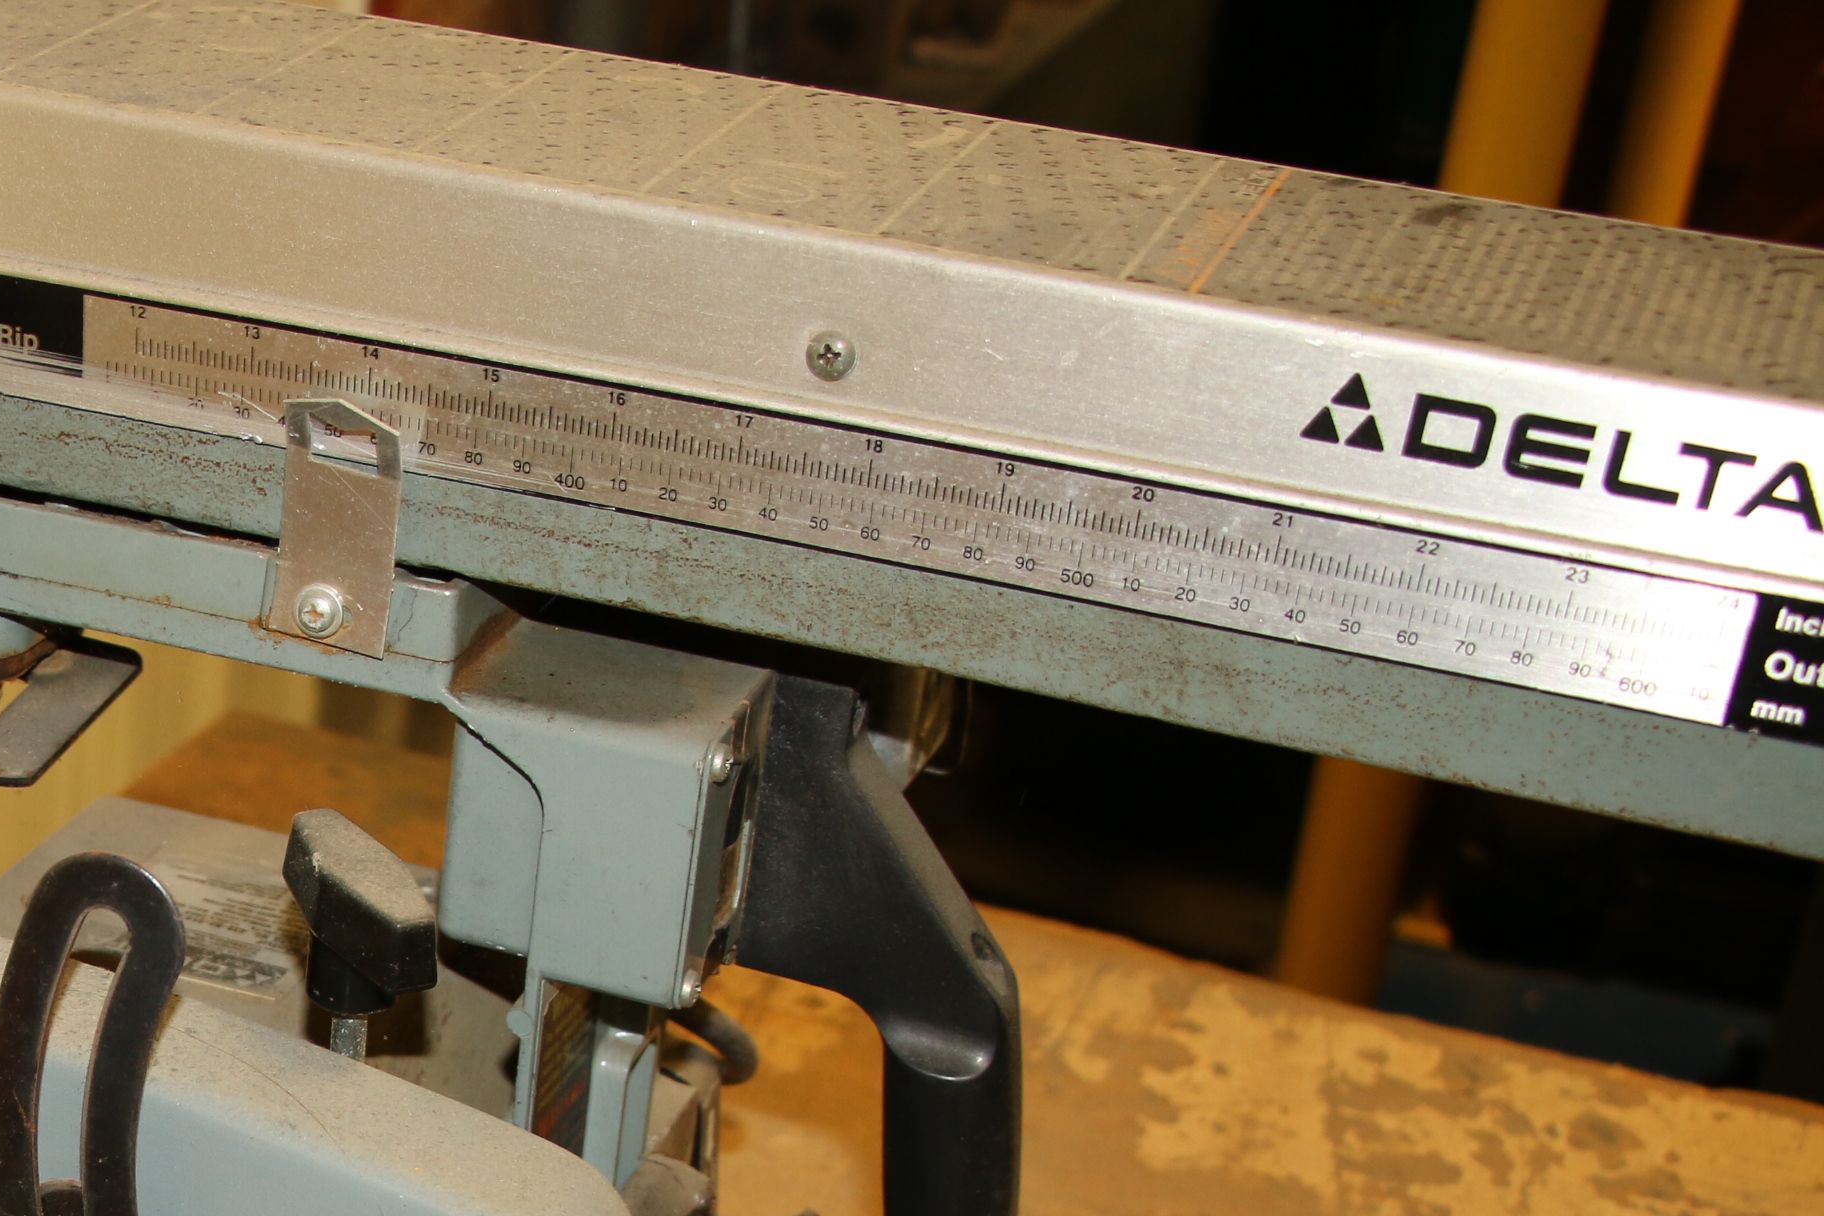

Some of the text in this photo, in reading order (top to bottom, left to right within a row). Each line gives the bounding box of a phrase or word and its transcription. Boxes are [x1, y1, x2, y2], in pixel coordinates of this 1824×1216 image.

[129, 305, 147, 319] 12
[244, 326, 260, 340] 13
[361, 347, 378, 361] 14
[483, 369, 500, 383] 15
[608, 392, 626, 406] 16
[735, 415, 754, 429] 17
[865, 438, 883, 453] 18
[996, 462, 1015, 477] 19
[1132, 487, 1155, 502] 20
[1273, 512, 1294, 527] 21
[1416, 540, 1440, 555] 22
[1565, 568, 1590, 584] 23
[1401, 392, 1824, 534] DELTA
[418, 441, 436, 456] 70
[464, 451, 483, 466] 80
[512, 460, 532, 475] 90
[554, 473, 585, 490] 400
[610, 477, 628, 492] 10
[658, 487, 677, 502] 20
[708, 497, 727, 512] 30
[758, 507, 778, 522] 40
[809, 516, 829, 532] 50
[860, 526, 880, 542] 60
[912, 536, 931, 551] 70
[962, 546, 983, 562] 80
[1015, 556, 1035, 572] 90
[1060, 569, 1094, 589] 500
[1122, 577, 1141, 592] 10
[1175, 587, 1196, 603] 20
[1229, 597, 1250, 613] 30
[1284, 607, 1306, 624] 40
[1339, 618, 1361, 635] 50
[1396, 630, 1419, 647] 60
[1454, 640, 1476, 657] 70
[1510, 651, 1533, 668] 80
[1568, 661, 1592, 679] 90
[1619, 677, 1657, 697] 600
[1750, 700, 1805, 725] mm
